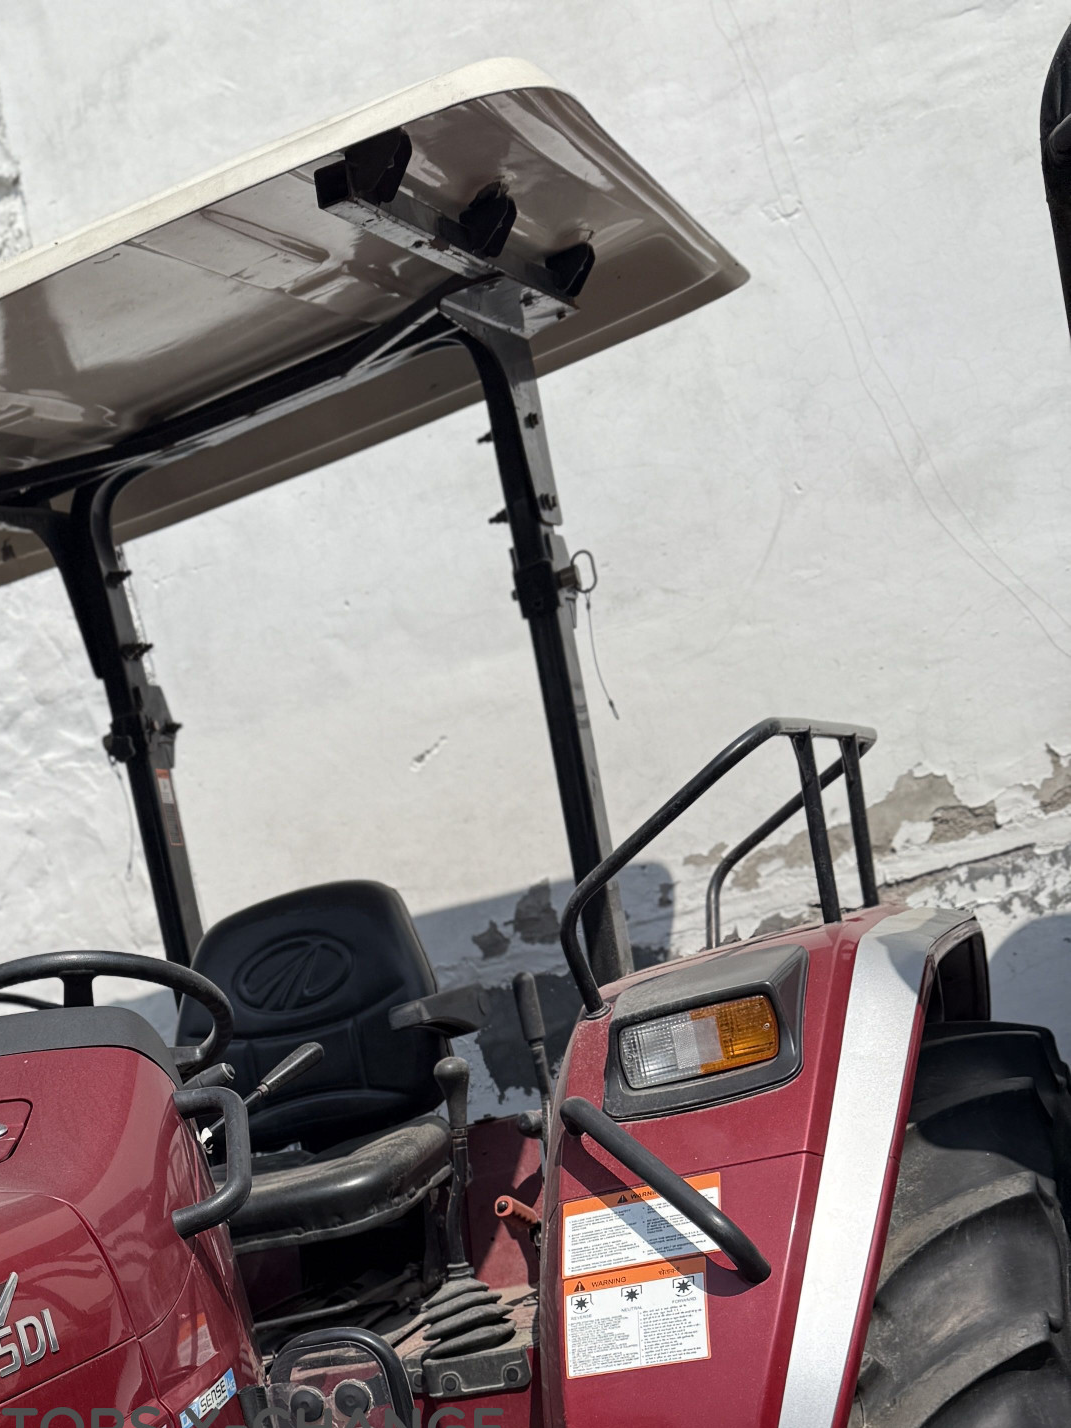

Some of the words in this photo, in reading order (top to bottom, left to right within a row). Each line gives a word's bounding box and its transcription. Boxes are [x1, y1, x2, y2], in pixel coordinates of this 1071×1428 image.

[591, 1277, 627, 1288] WARNING
[671, 1296, 697, 1304] FORWARD
[621, 1305, 643, 1313] NEUTRAL
[570, 1313, 593, 1321] REVERSE
